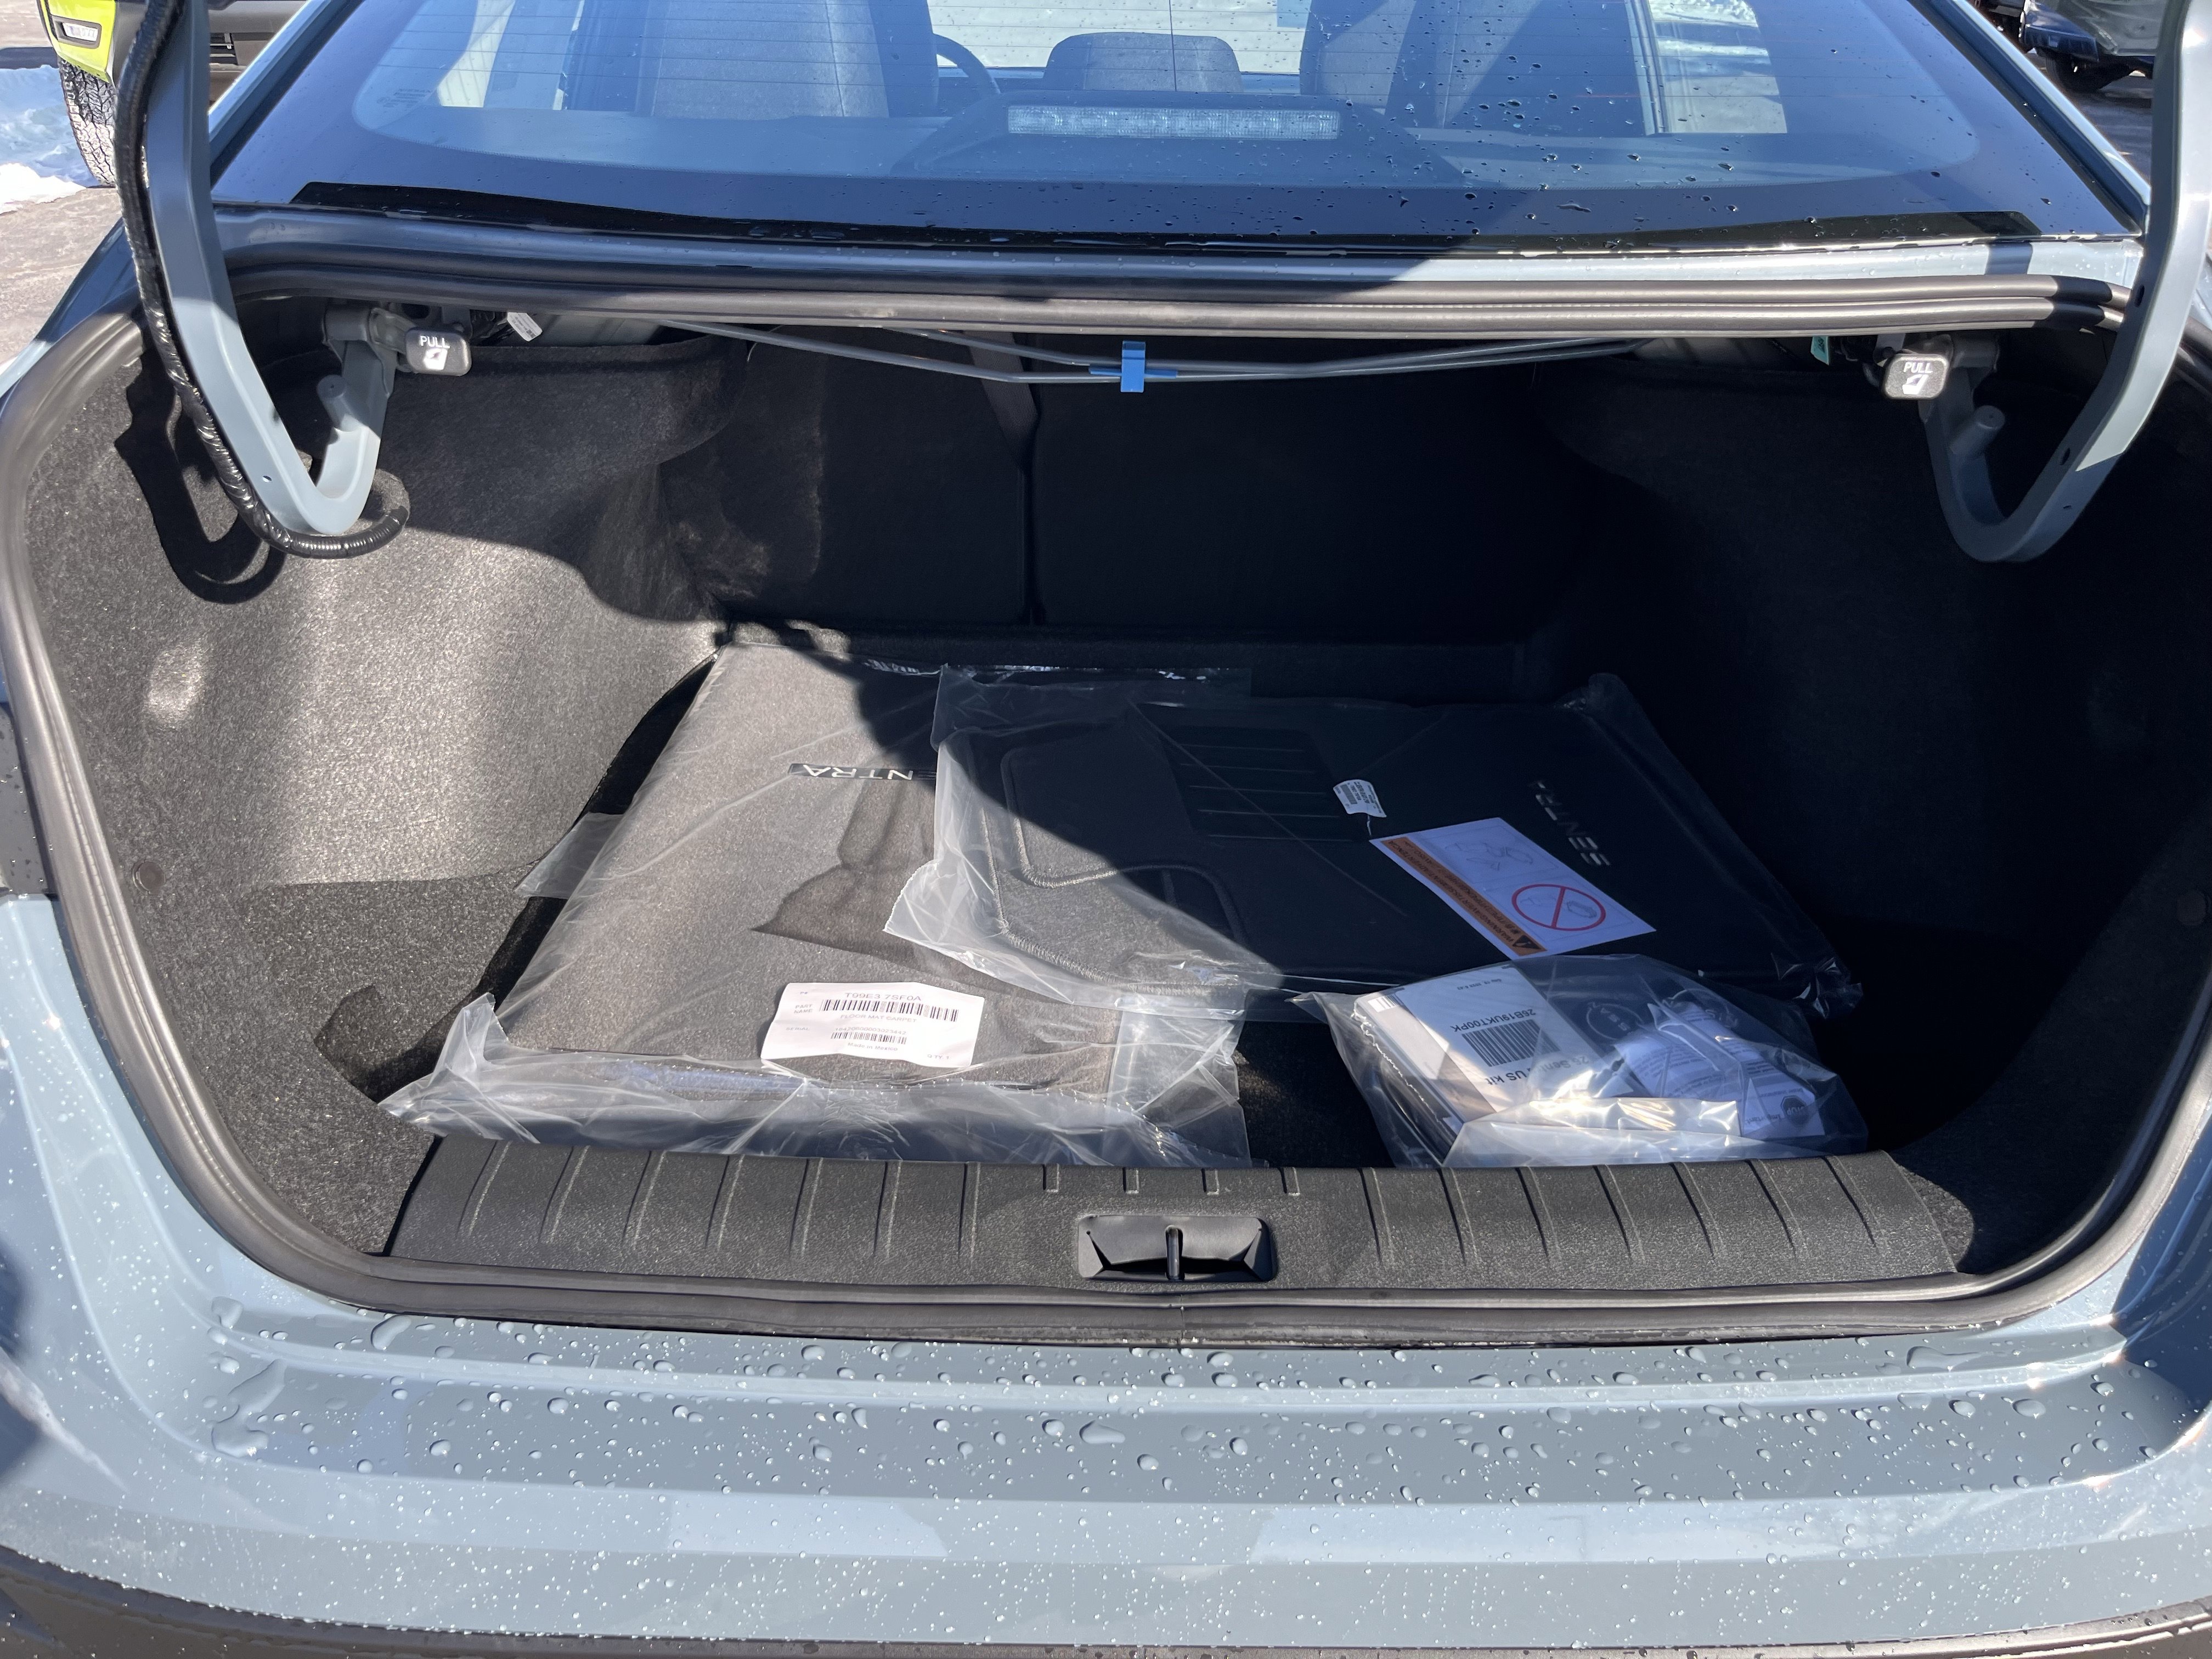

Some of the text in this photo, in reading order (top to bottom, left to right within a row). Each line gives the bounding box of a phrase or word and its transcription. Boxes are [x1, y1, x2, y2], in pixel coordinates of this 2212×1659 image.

[420, 335, 450, 348] PULL
[1903, 362, 1933, 374] PULL
[1450, 1009, 1536, 1032] 26B19UKT00PK
[1485, 1075, 1505, 1085] kit
[1506, 1070, 1527, 1081] US
